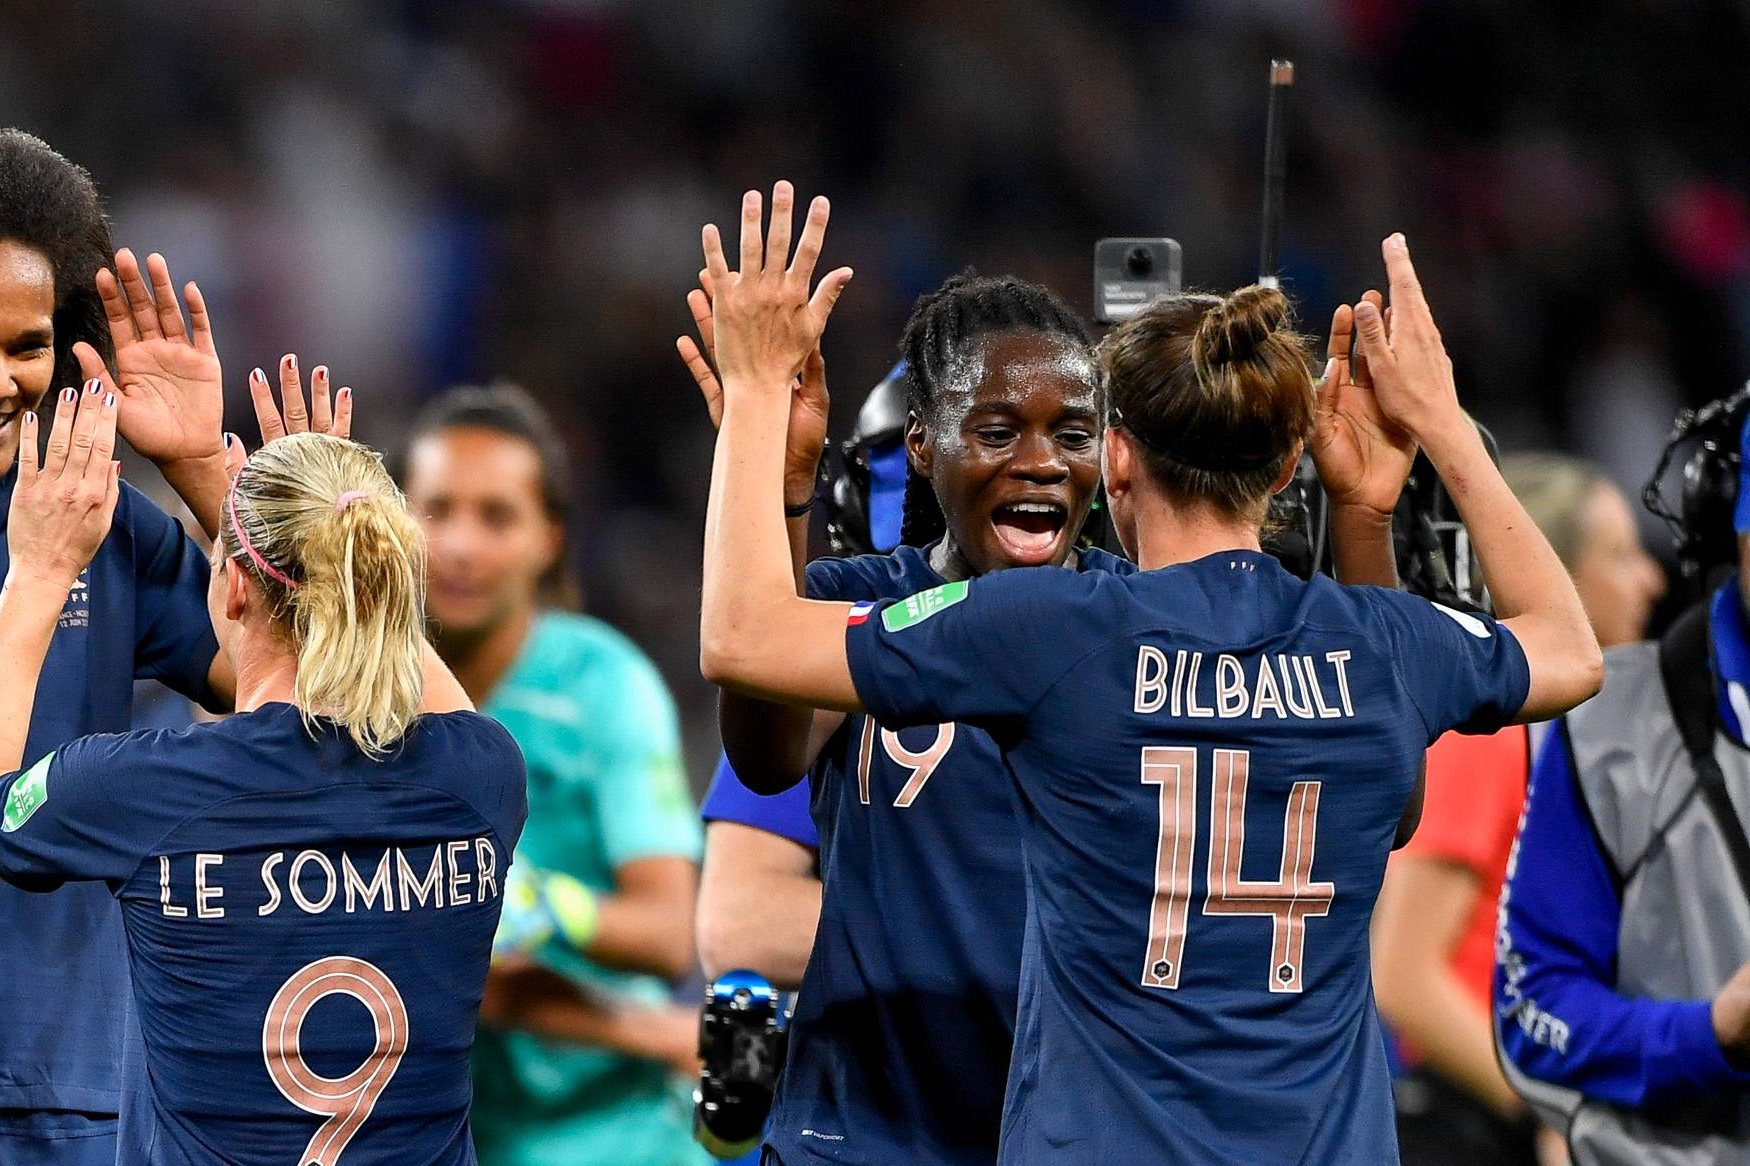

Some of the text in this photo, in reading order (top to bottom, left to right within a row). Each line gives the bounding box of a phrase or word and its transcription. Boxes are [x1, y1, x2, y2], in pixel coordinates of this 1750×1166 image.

[1133, 645, 1355, 718] BILBAULT
[858, 716, 956, 808] 19
[158, 837, 499, 920] LE SOMMER
[1140, 746, 1336, 994] 14
